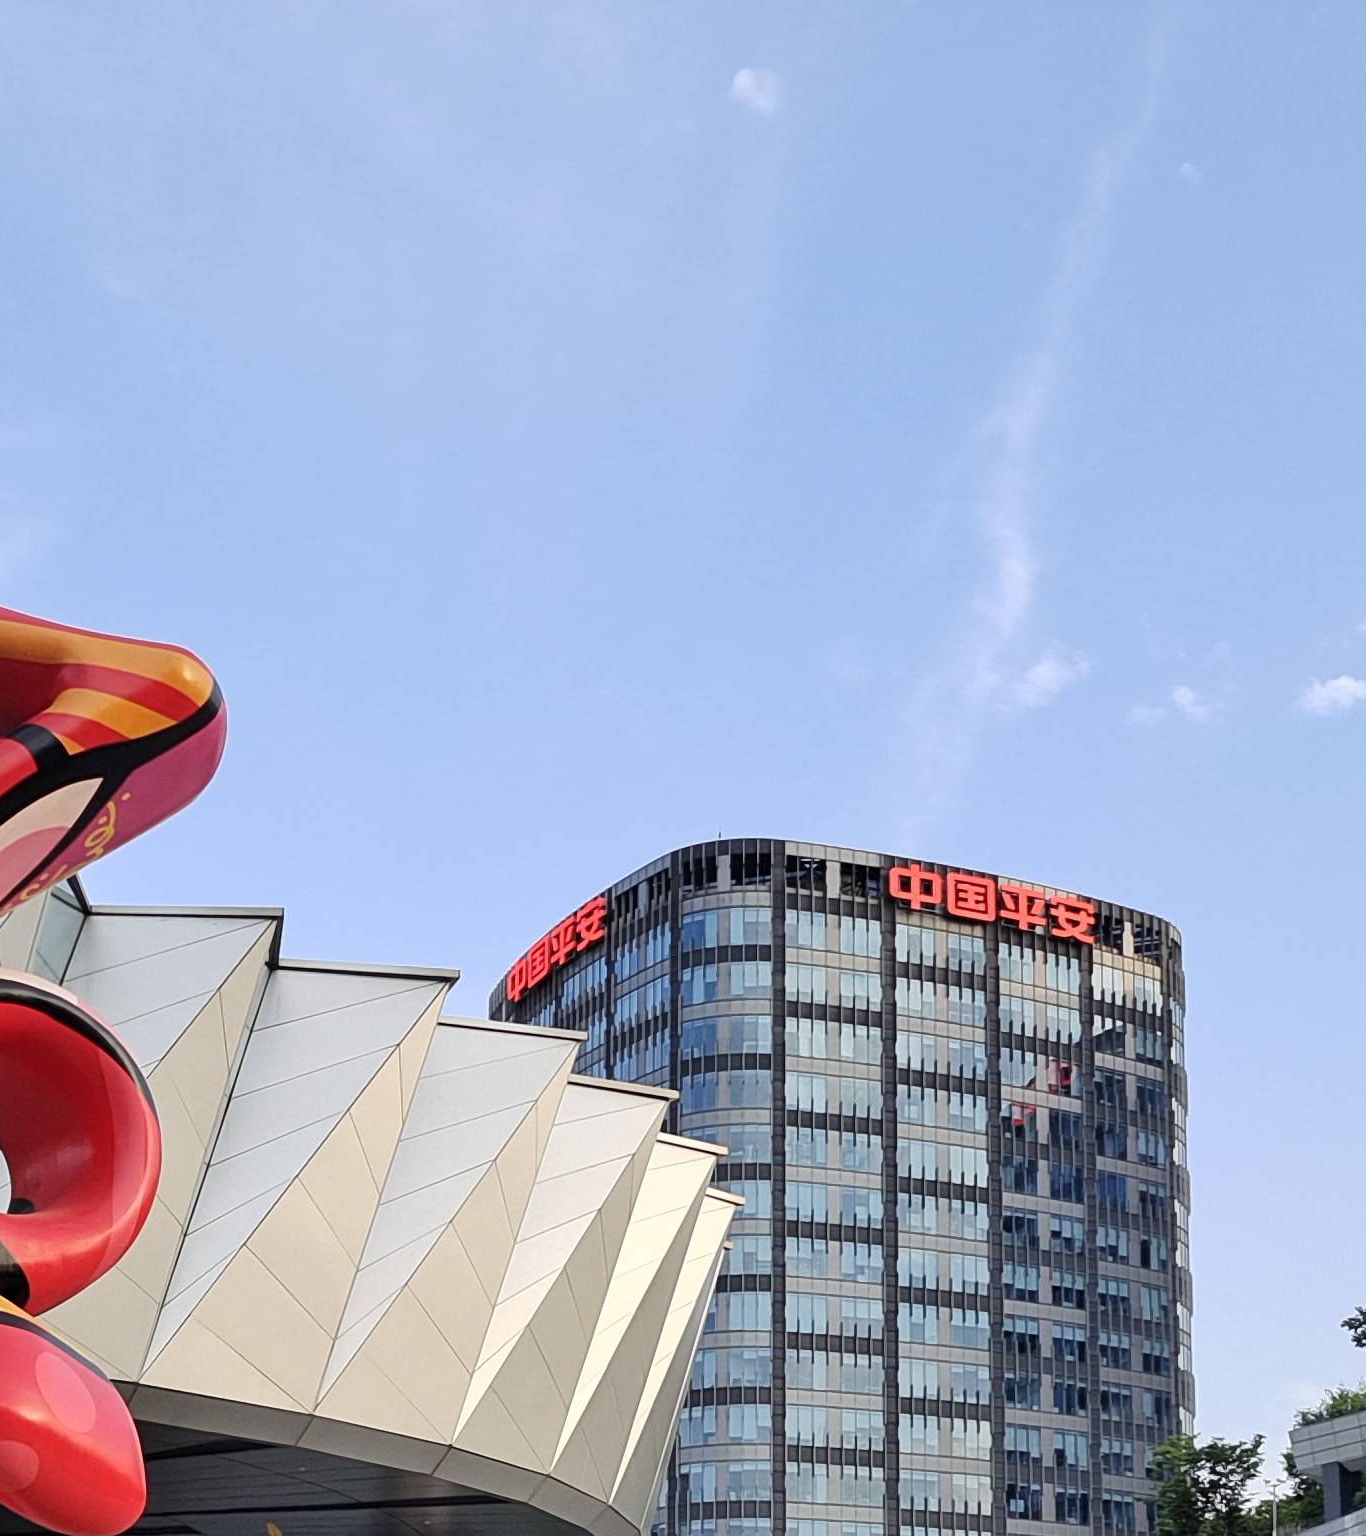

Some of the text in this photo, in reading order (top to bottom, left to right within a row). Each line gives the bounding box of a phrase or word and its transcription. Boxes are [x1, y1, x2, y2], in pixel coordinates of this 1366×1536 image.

[506, 896, 607, 1002] 中国平安
[889, 864, 1096, 945] 中国平安
